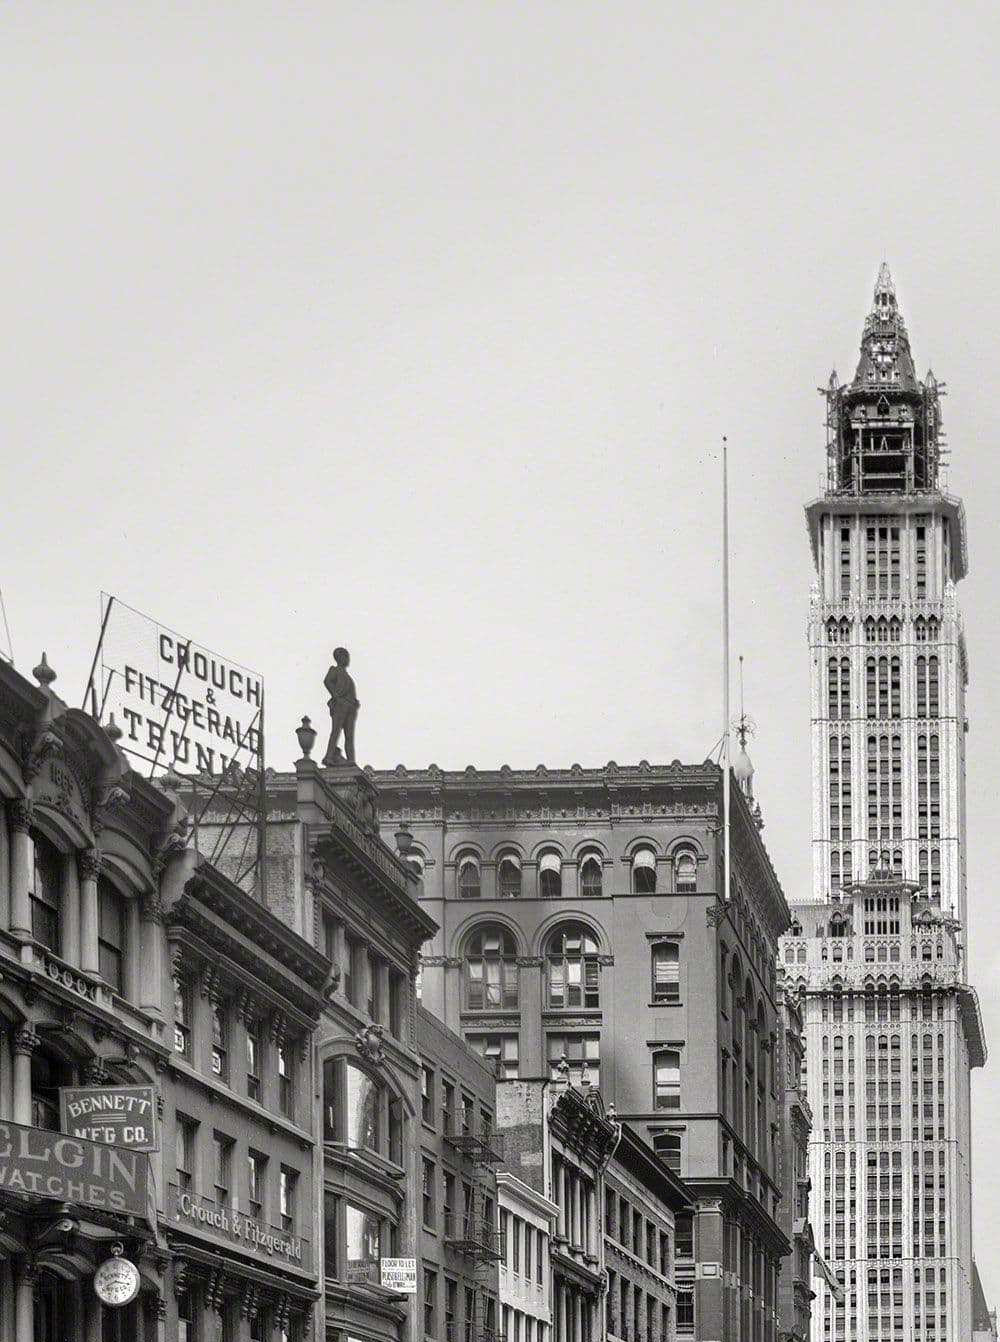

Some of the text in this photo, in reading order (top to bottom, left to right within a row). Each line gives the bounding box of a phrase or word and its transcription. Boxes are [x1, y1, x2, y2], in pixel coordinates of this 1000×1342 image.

[159, 633, 261, 708] CROUCH
[125, 664, 260, 754] FITZGERALD
[205, 687, 217, 707] &
[68, 1094, 151, 1118] BENNETT
[123, 1126, 149, 1143] CO.
[181, 1194, 302, 1260] Crouch & Fitzgerald
